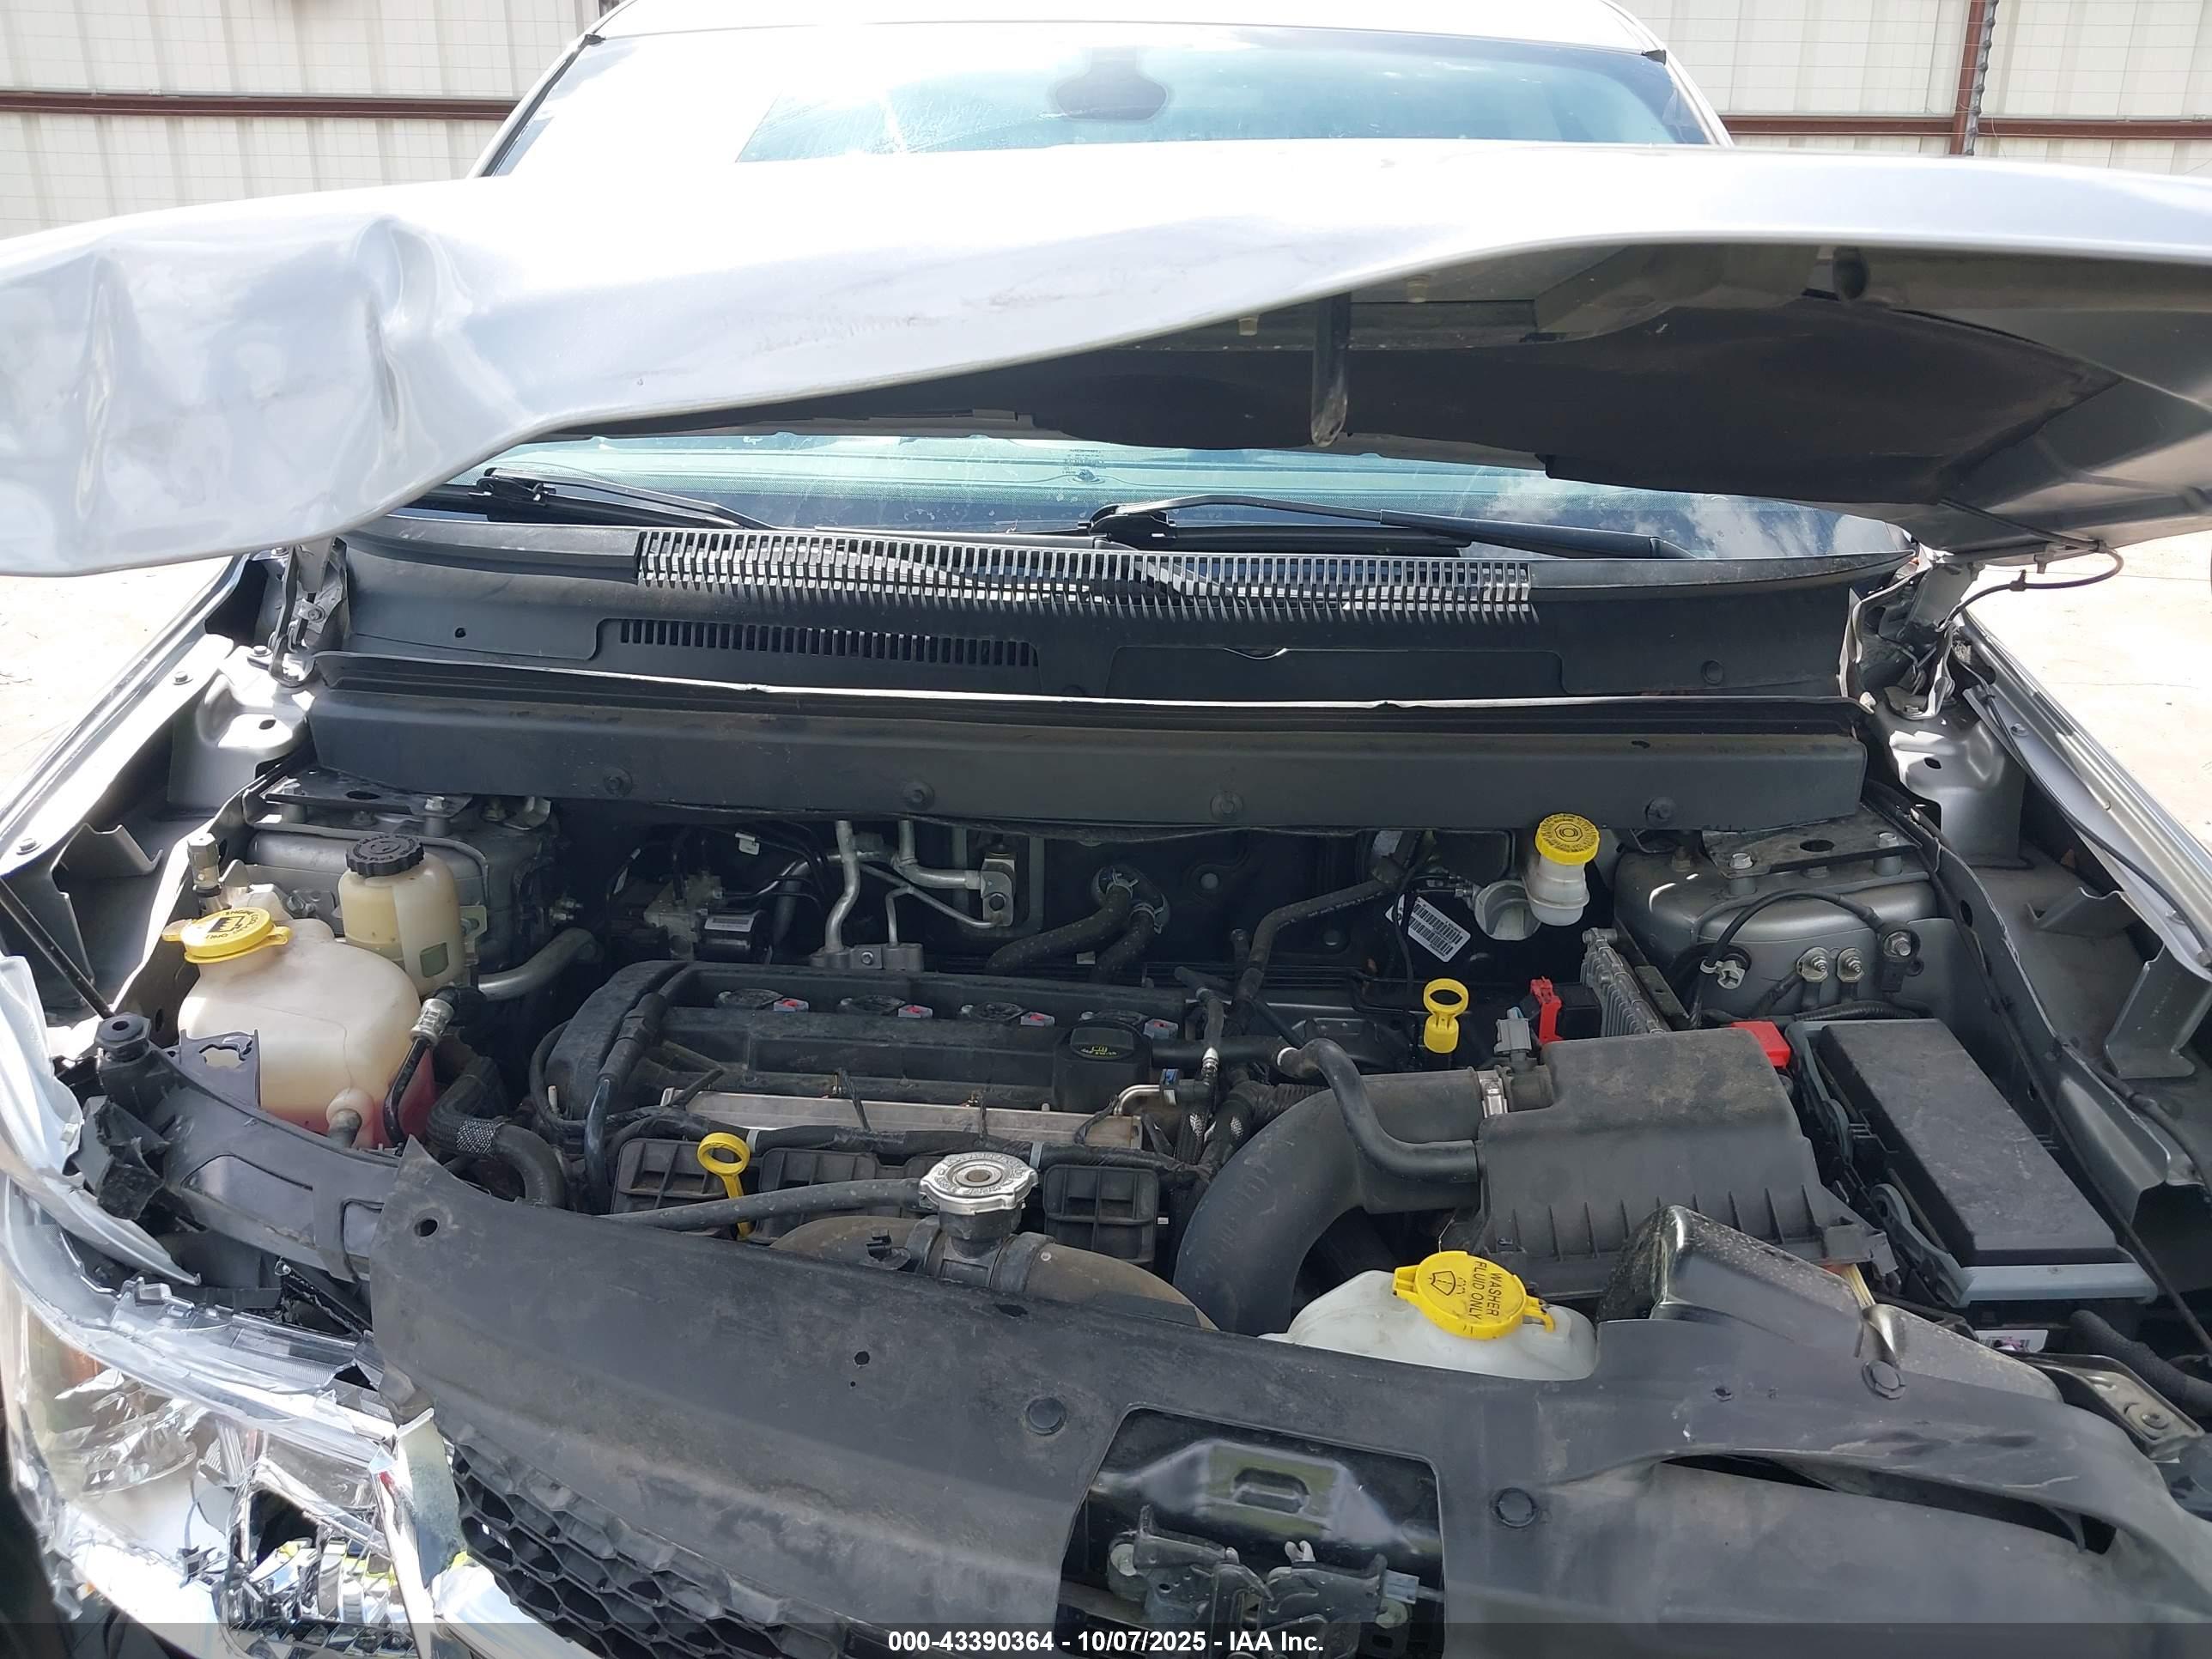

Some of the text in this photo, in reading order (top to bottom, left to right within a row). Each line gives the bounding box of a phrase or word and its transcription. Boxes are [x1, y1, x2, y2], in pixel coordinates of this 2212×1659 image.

[1468, 1261, 1487, 1320] FLUID ONLY
[1486, 1273, 1502, 1316] WASHER
